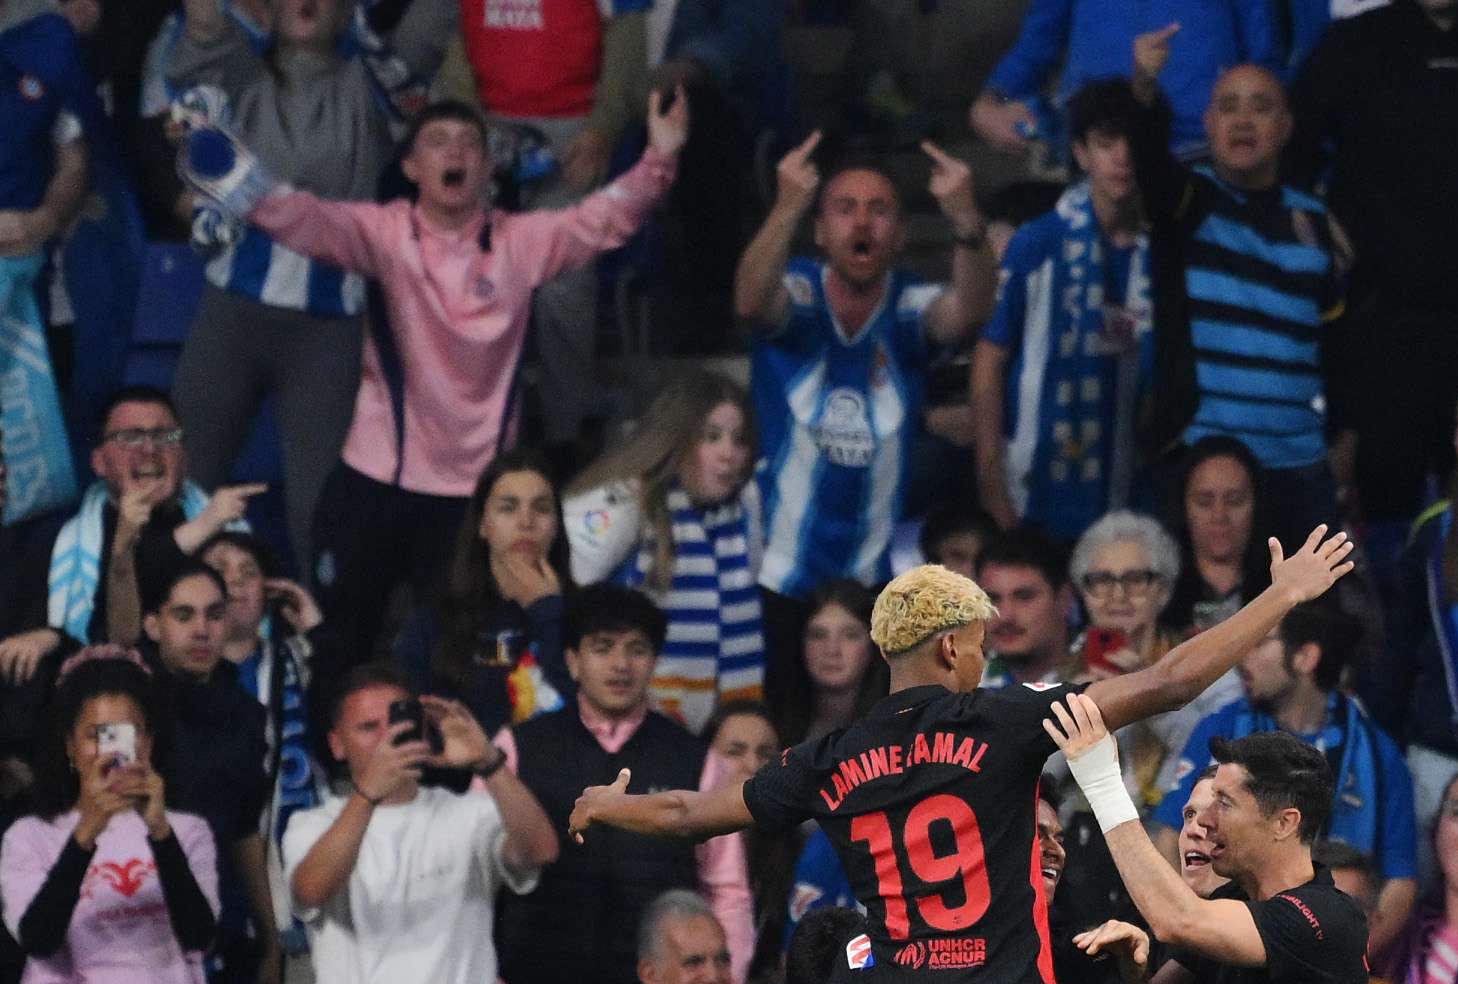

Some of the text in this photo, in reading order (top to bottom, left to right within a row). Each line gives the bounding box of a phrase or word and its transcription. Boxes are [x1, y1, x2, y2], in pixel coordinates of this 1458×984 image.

[819, 745, 904, 812] LAMINE
[851, 793, 992, 940] 19
[928, 938, 986, 952] UNHCR
[928, 950, 986, 965] ACNUR
